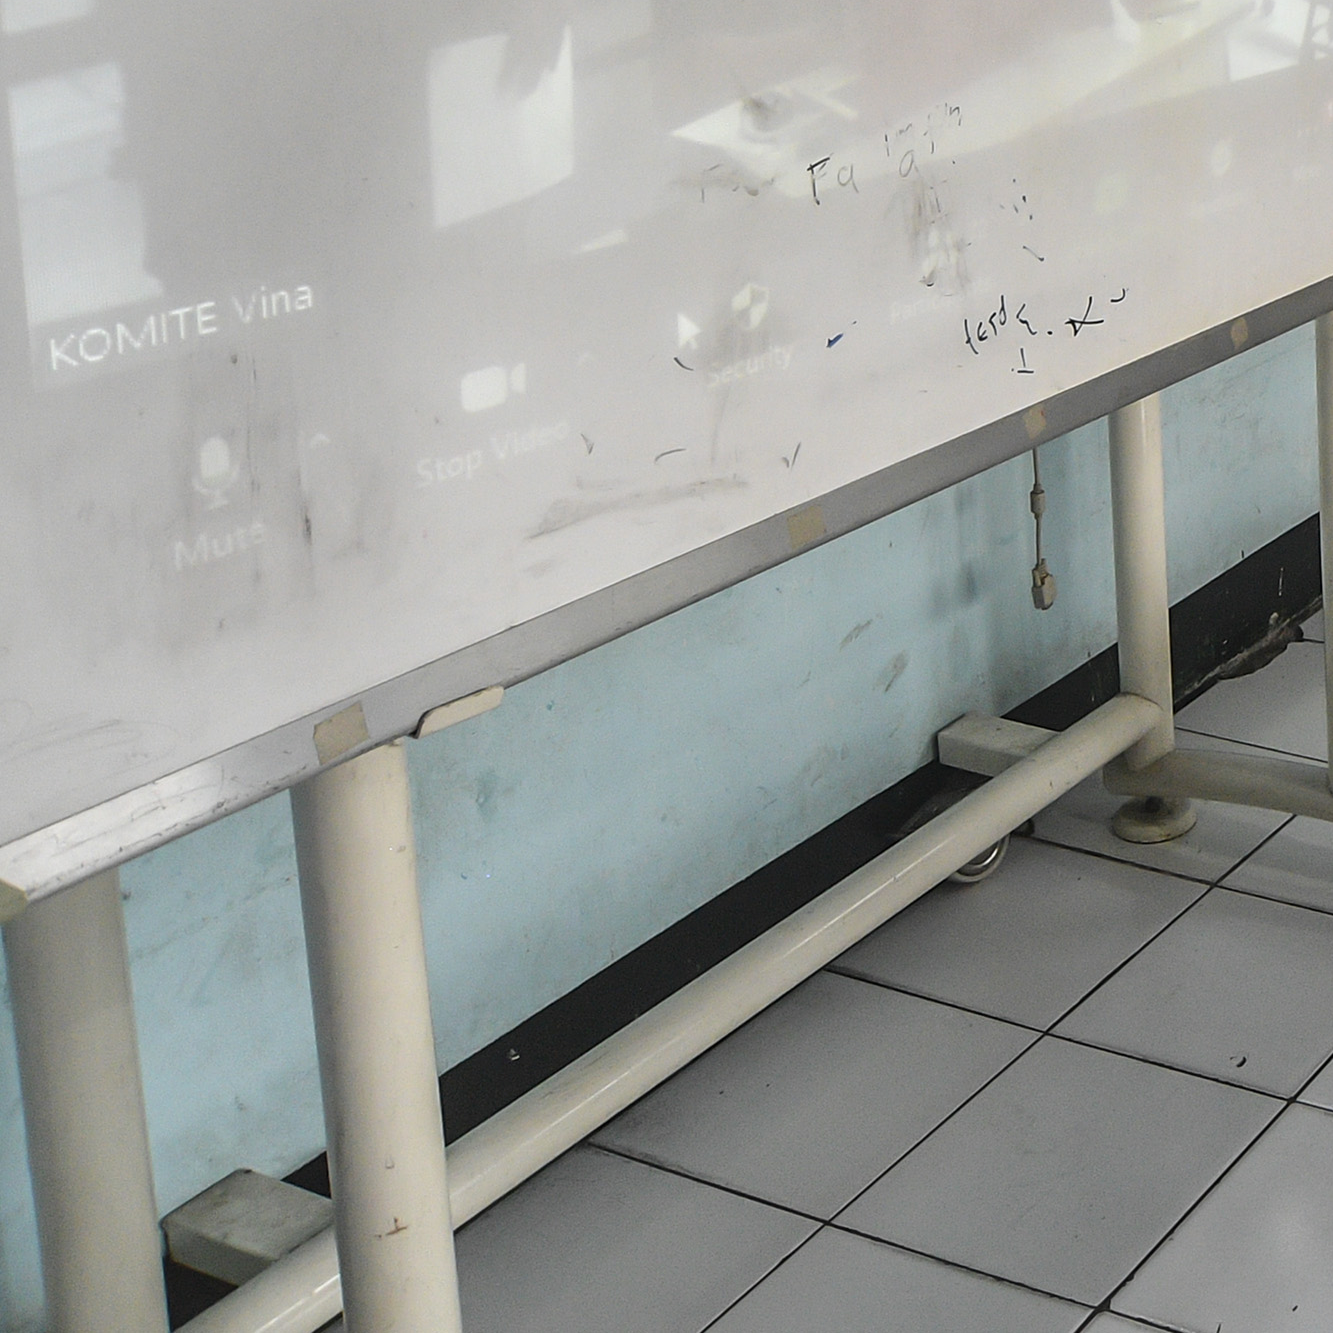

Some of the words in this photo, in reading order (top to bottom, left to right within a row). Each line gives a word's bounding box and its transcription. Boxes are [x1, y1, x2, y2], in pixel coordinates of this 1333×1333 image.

[50, 301, 218, 370] KOMITE
[232, 285, 312, 324] Vina
[707, 346, 792, 389] Security
[415, 449, 484, 488] Stop
[489, 420, 570, 460] Video
[173, 520, 267, 572] Mute
